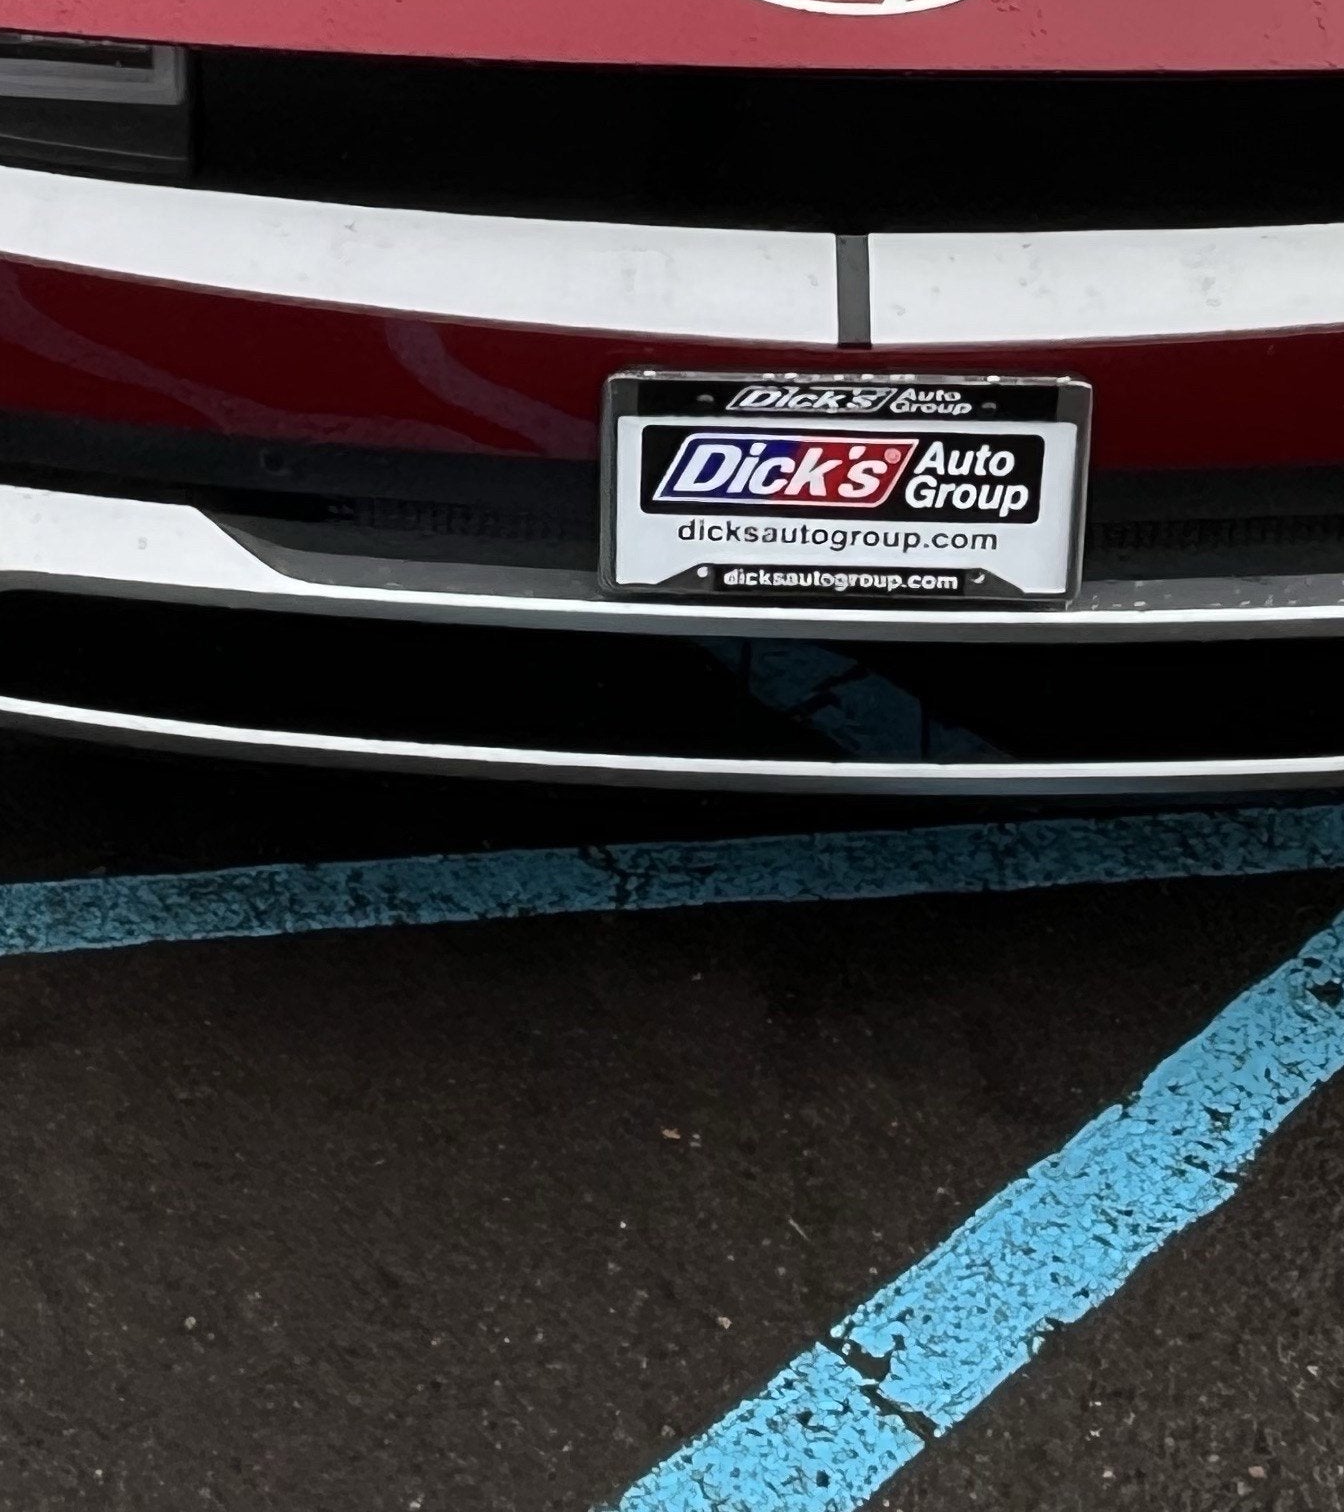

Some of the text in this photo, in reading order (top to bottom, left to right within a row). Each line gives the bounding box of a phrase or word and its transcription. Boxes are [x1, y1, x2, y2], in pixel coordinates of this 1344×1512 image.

[889, 401, 973, 415] Group
[901, 389, 962, 402] Auto
[673, 441, 1016, 499] Dick's Auto
[904, 475, 1030, 518] Group
[677, 519, 998, 553] dicksautogroup.com
[723, 568, 958, 593] dicksautogroup.com
